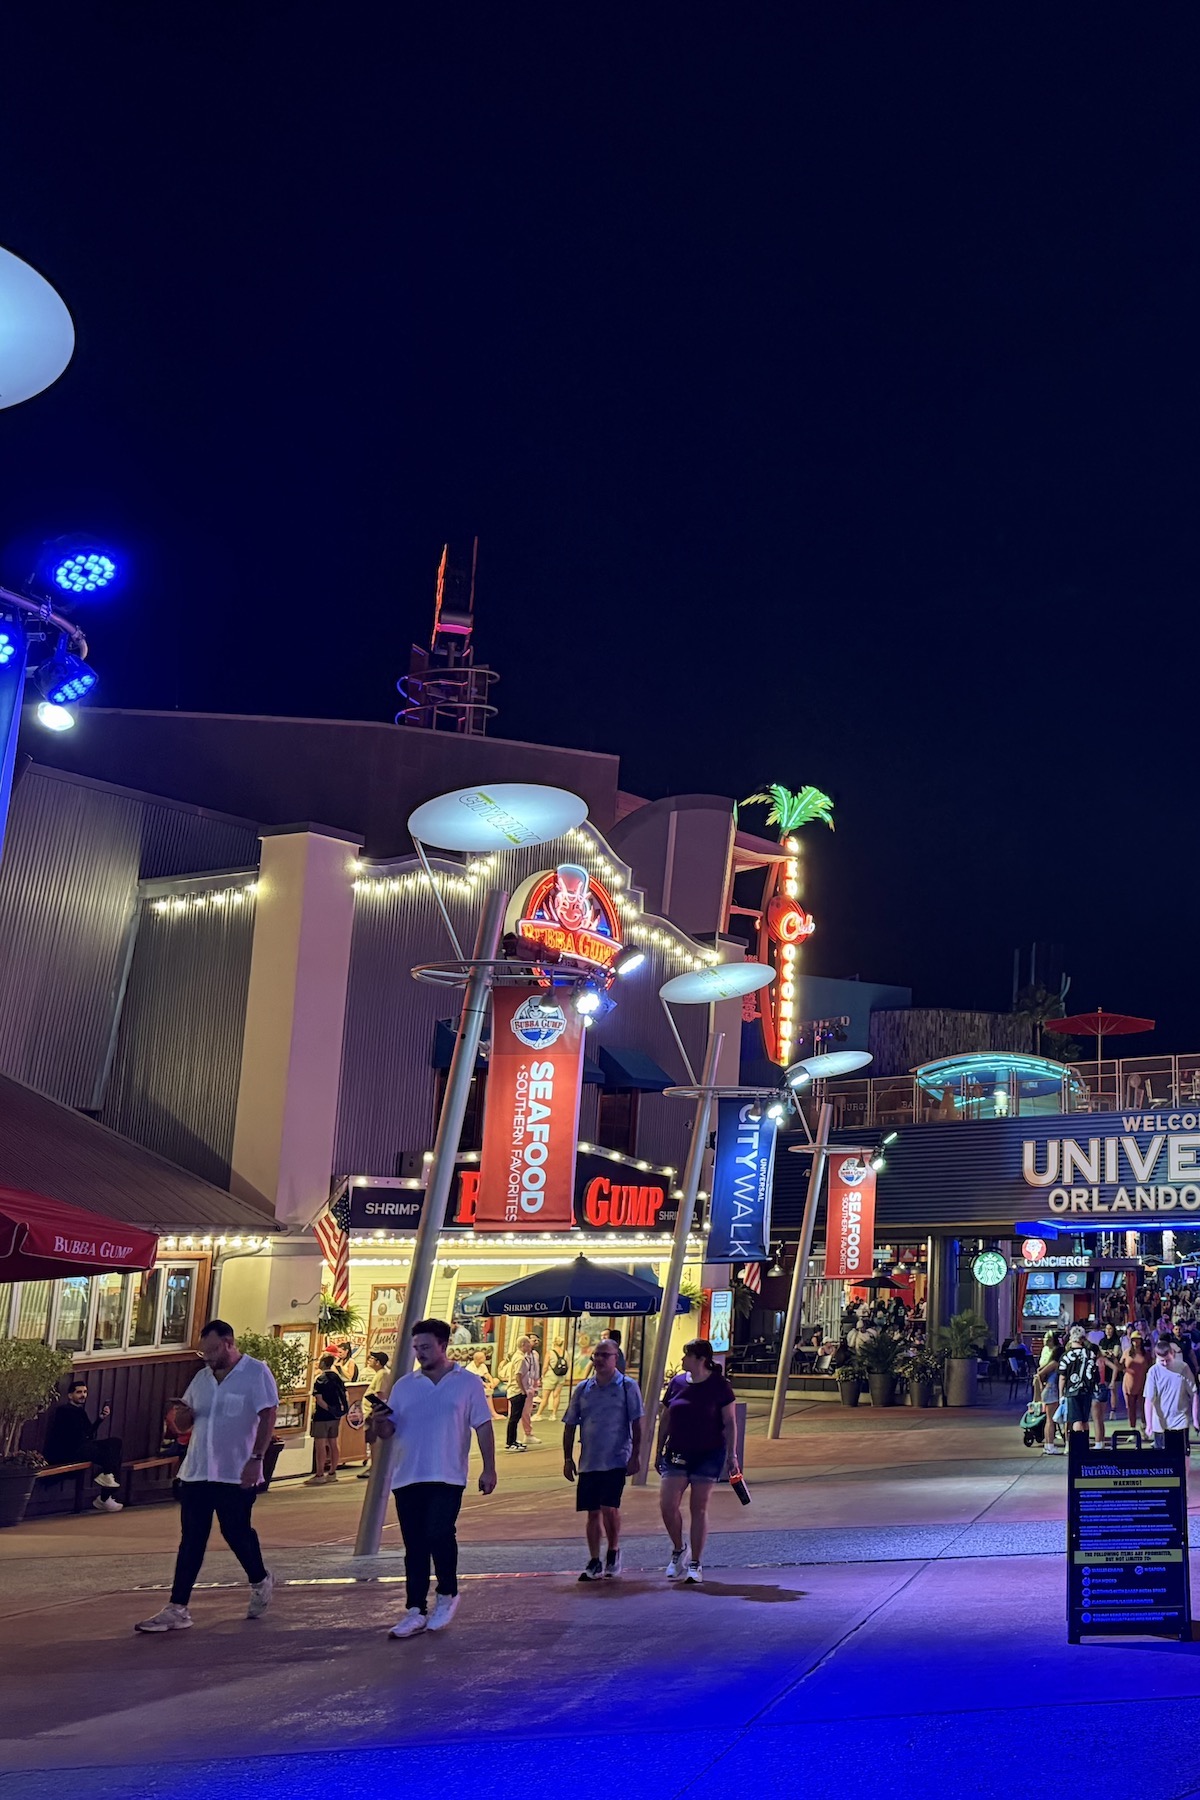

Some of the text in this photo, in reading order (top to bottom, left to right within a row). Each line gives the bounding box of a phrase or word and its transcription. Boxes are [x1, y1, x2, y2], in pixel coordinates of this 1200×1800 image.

[514, 1019, 563, 1030] BUBBA GUMP
[520, 1061, 554, 1214] SEAFOOD
[504, 1149, 522, 1222] FAVORITES
[729, 1104, 761, 1256] CITYWALK
[757, 1158, 767, 1202] UNIVERSAL
[365, 1202, 420, 1215] SHRIMP
[584, 1176, 664, 1227] GUMP
[847, 1191, 862, 1270] SEAFOOD
[53, 1236, 134, 1259] BUBBA GUMP
[839, 1236, 847, 1275] FAVORITES
[1024, 1256, 1091, 1267] CONCIERGE
[503, 1302, 549, 1312] SHRIMP CO.
[584, 1301, 638, 1310] BUBBA GUMP
[1081, 1467, 1174, 1477] HALLOWEEN HORROR NIGHTS
